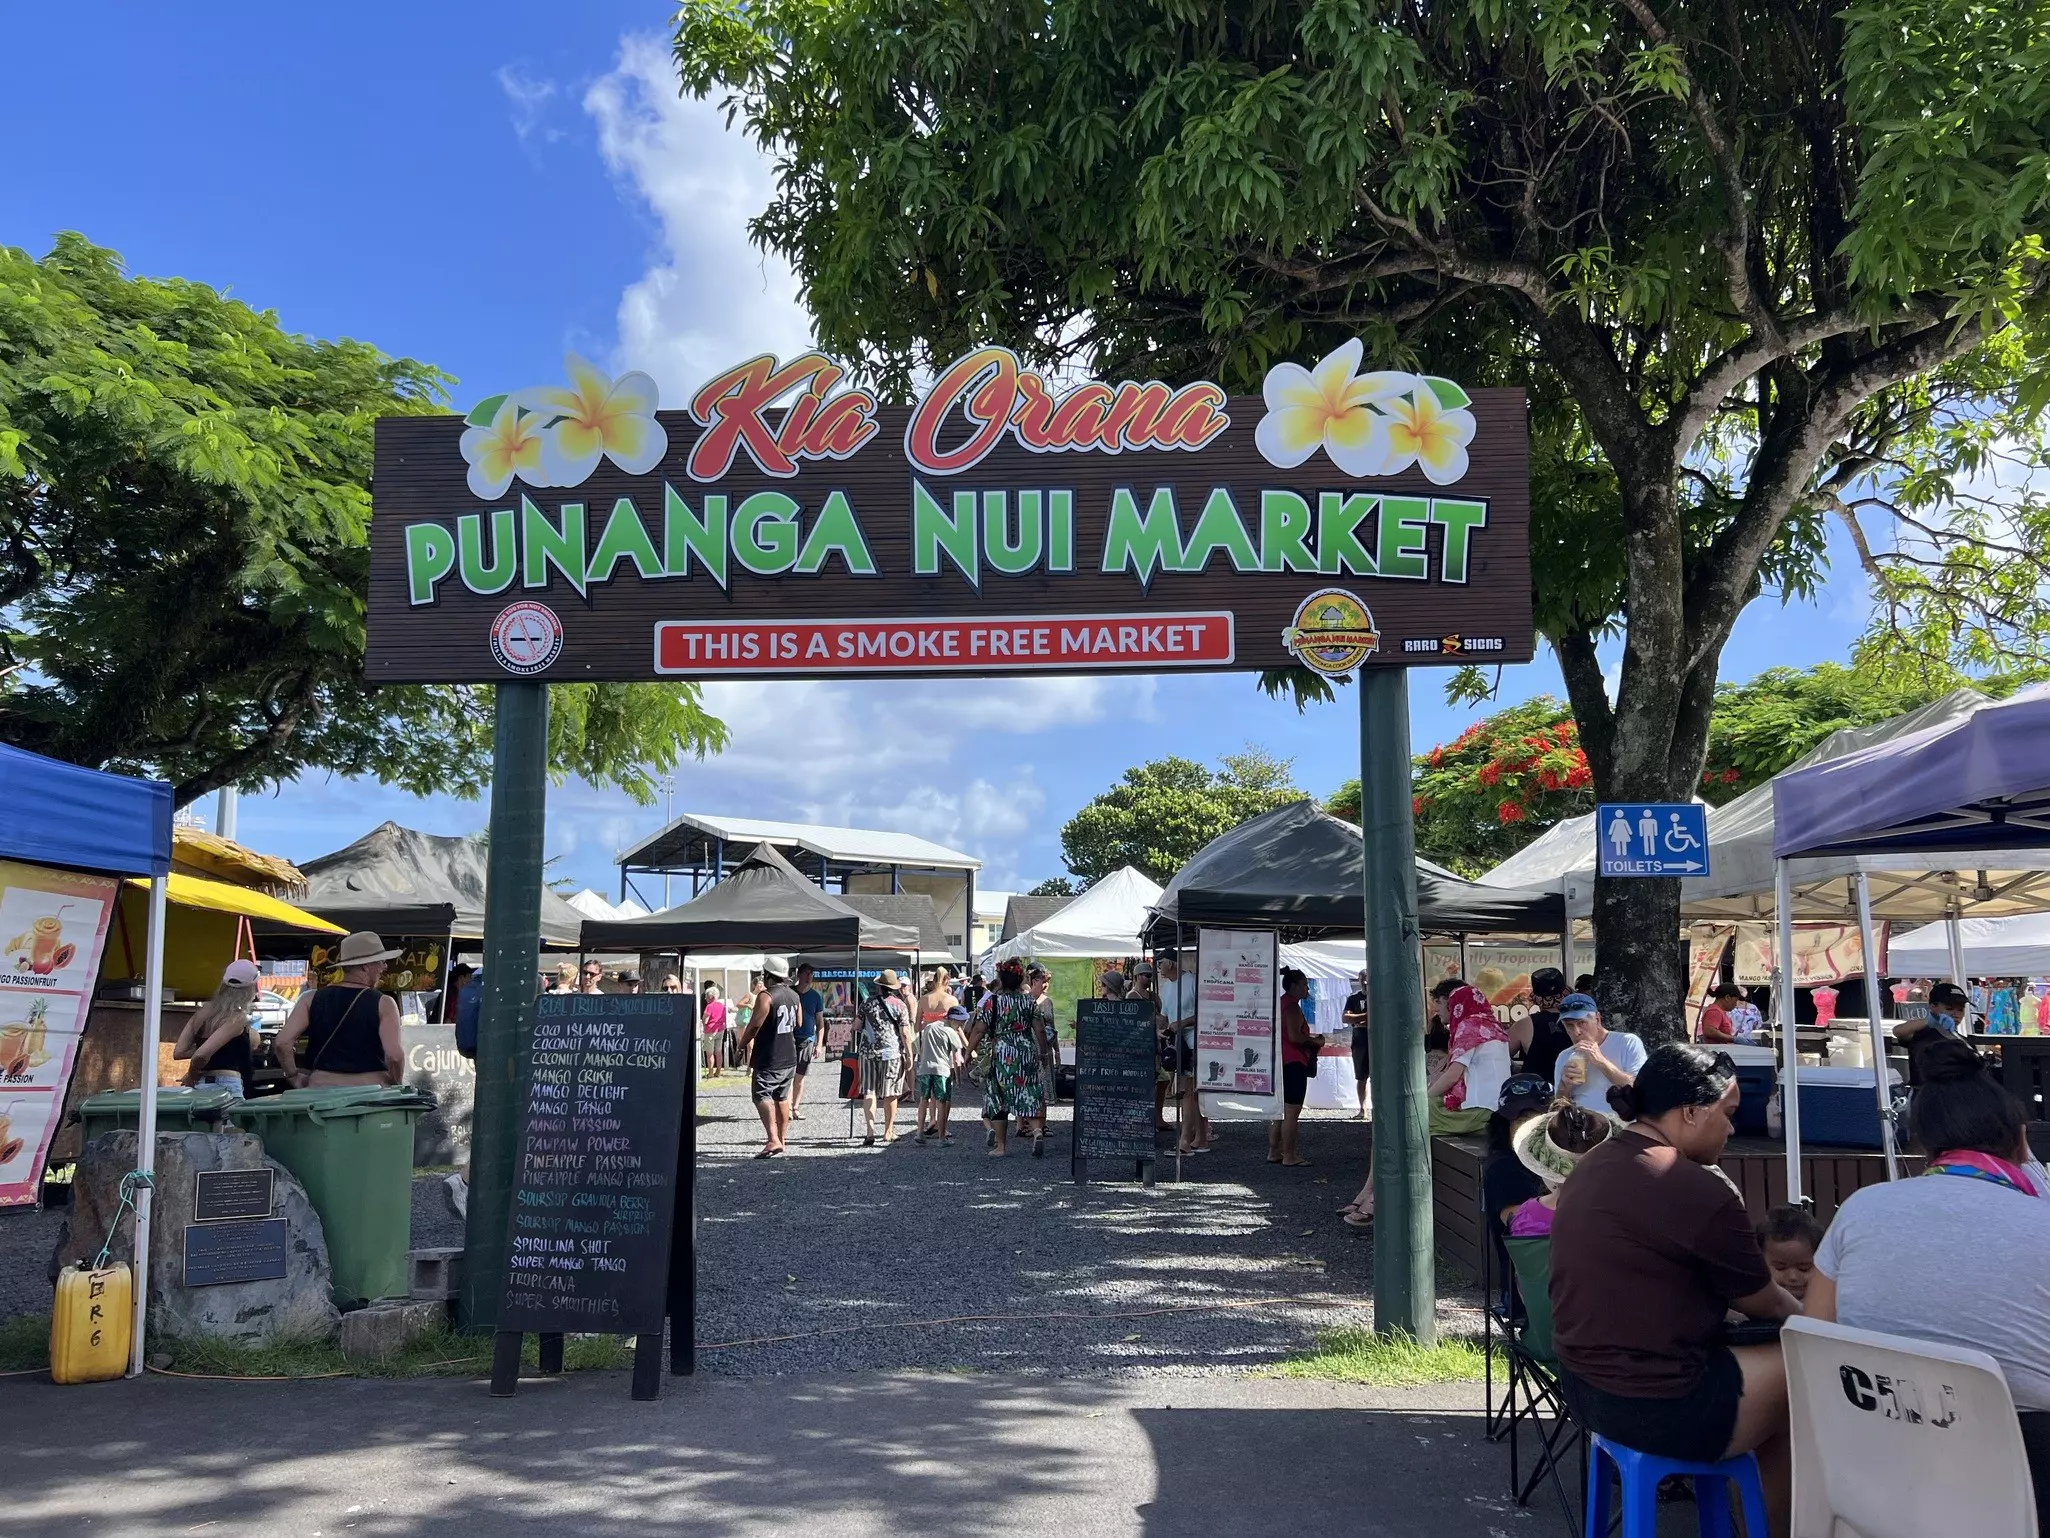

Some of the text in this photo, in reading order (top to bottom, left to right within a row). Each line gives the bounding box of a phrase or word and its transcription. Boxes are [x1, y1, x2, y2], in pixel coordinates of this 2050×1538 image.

[689, 347, 1229, 482] Kia Orana
[404, 477, 1489, 606] PUNANGA NUI MARKET
[682, 624, 1206, 660] THIS IS A SMOKE FREE MARKET
[1404, 639, 1438, 652] RARO
[1464, 638, 1503, 650] SIGNS
[1605, 860, 1663, 872] TOILETS
[1496, 951, 1553, 966] Tropical
[12, 975, 57, 987] PASSIONFRUIT
[538, 997, 566, 1015] REAL
[534, 1023, 625, 1037] COCO ISLANDER
[532, 1038, 671, 1053] COCONUT MANGO TANGO
[532, 1052, 667, 1069] COCONUT MANGO CRUSH
[4, 1075, 34, 1083] PASSION
[532, 1069, 613, 1085] MANGO CRUSH
[530, 1083, 629, 1100] MANGO DELIGHT
[528, 1100, 612, 1115] MANGO TANGO
[526, 1117, 622, 1133] MANGO PASSION
[527, 1136, 631, 1152] PAWPAW POWER
[525, 1154, 641, 1170] PINEAPPLE PASSION
[523, 1170, 668, 1188] PINEAPPLE MANGO PASSION
[620, 1195, 650, 1210] BERRY
[565, 1218, 599, 1233] MANGO
[604, 1221, 650, 1236] PASSION
[513, 1236, 612, 1255] SPIRULINA SHOT
[511, 1255, 627, 1272] SUPER MANGO TANGO
[508, 1272, 575, 1293] TROPICANA
[506, 1290, 619, 1317] SUPER SMOOTHIES
